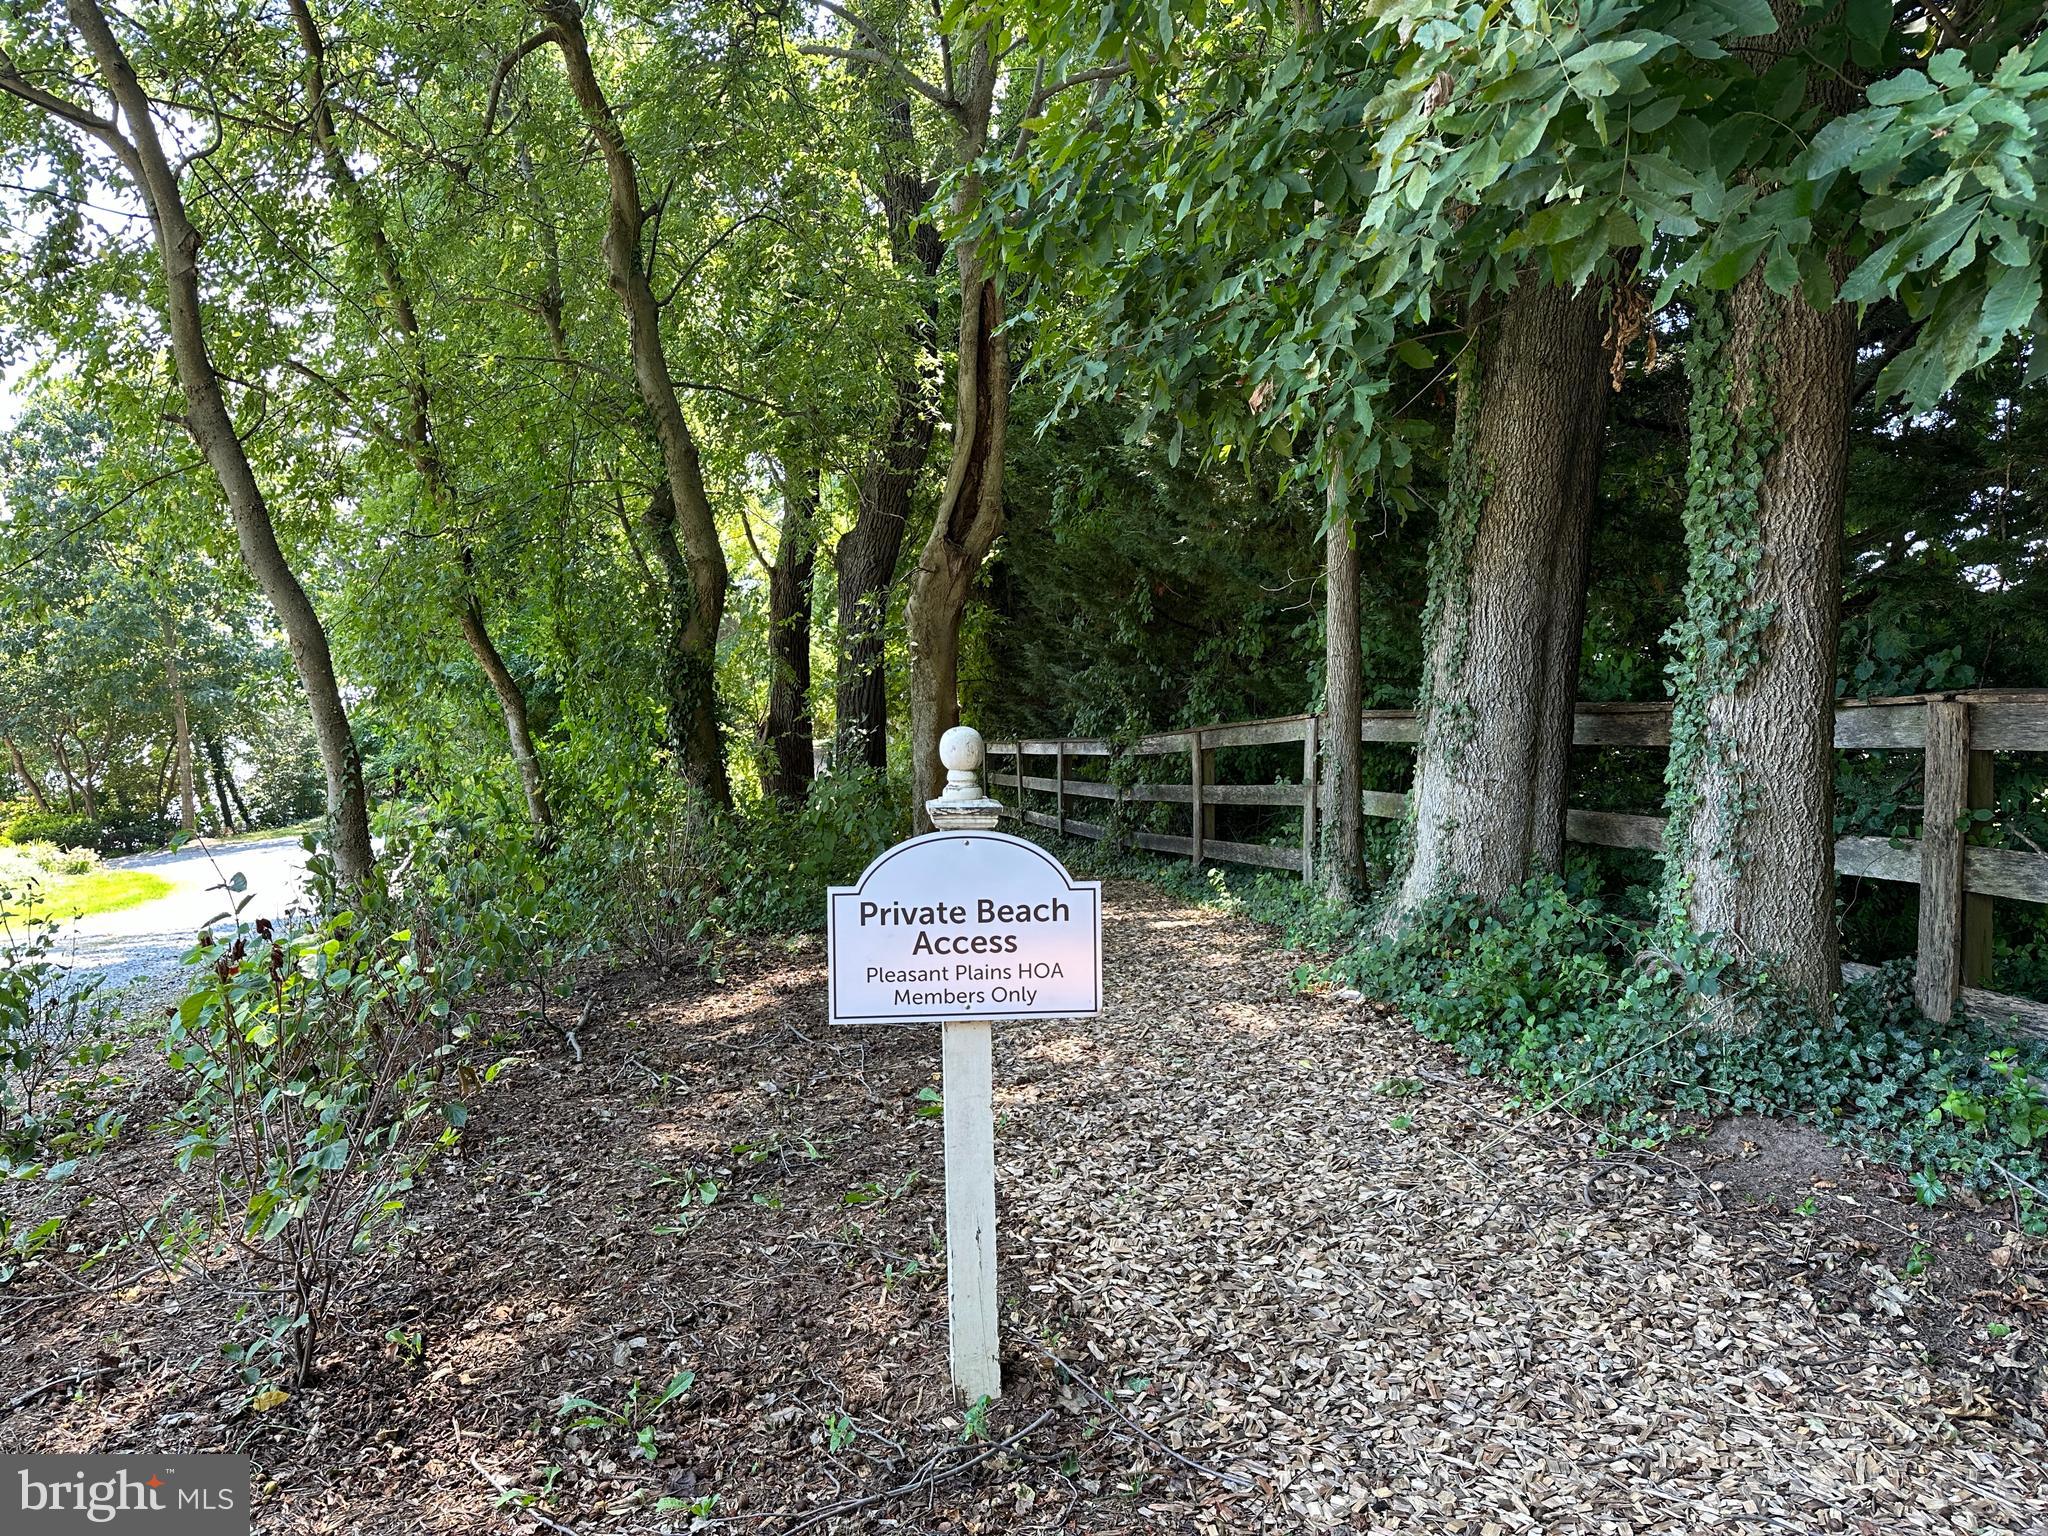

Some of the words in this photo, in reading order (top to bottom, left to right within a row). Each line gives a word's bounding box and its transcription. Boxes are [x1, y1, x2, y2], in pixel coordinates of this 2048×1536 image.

[860, 901, 966, 926] Private
[977, 897, 1070, 923] Beach
[912, 930, 1018, 955] Access
[866, 966, 949, 983] Pleasant
[955, 963, 1012, 981] Plains
[1018, 962, 1064, 979] HOA
[894, 987, 985, 1006] Members
[991, 985, 1038, 1006] Only
